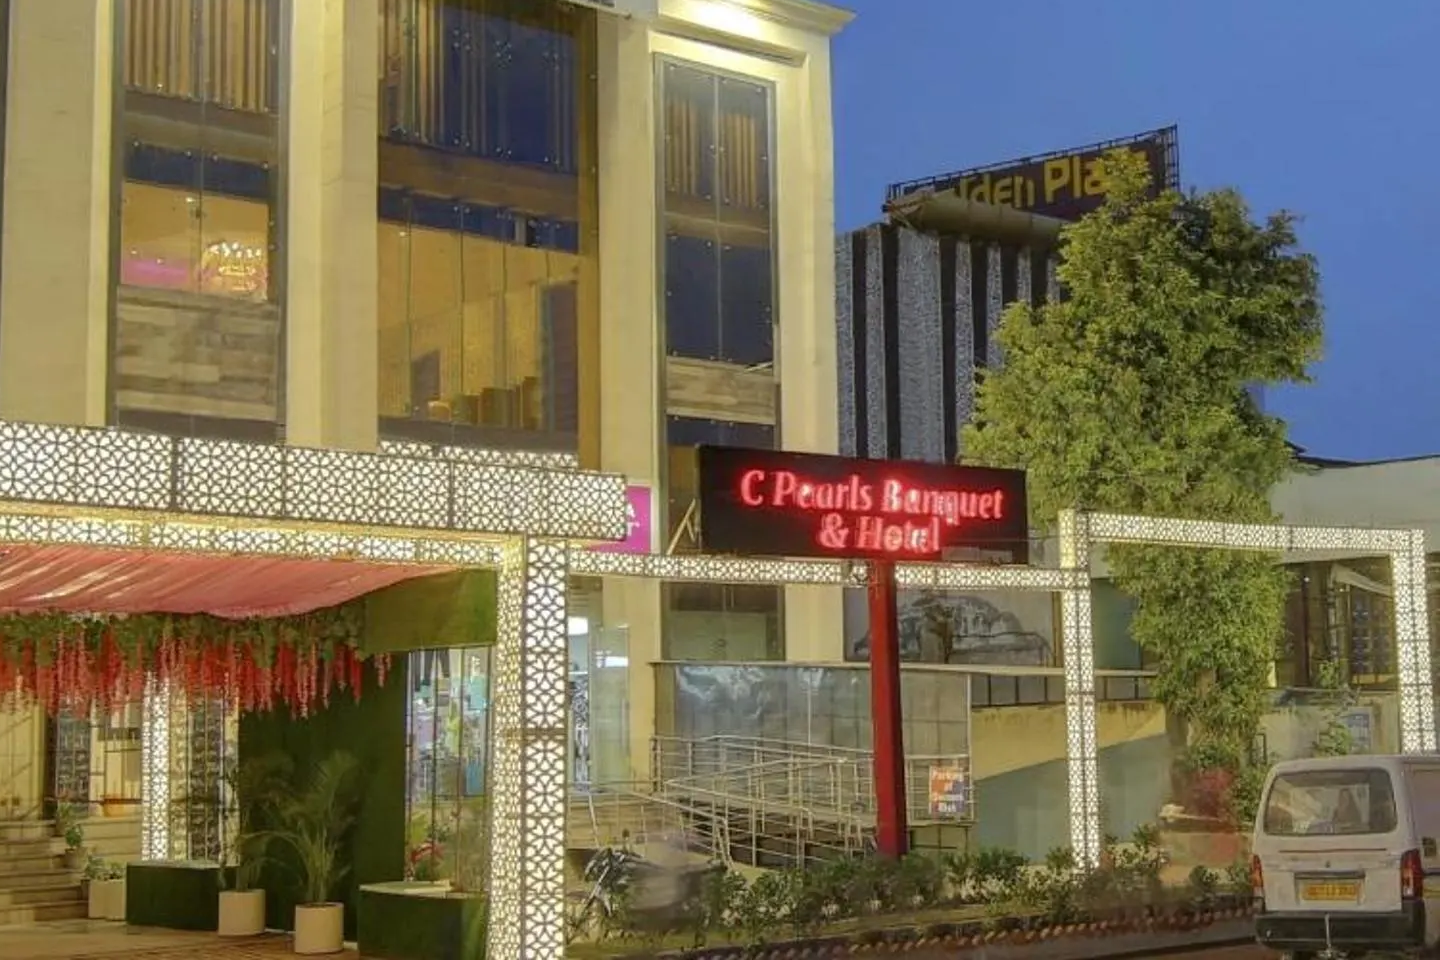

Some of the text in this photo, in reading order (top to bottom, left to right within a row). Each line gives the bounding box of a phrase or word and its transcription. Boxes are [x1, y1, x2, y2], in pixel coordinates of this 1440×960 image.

[954, 171, 1035, 209] lden
[741, 469, 1004, 525] C Pearls Banquet
[818, 512, 940, 553] & Hotel
